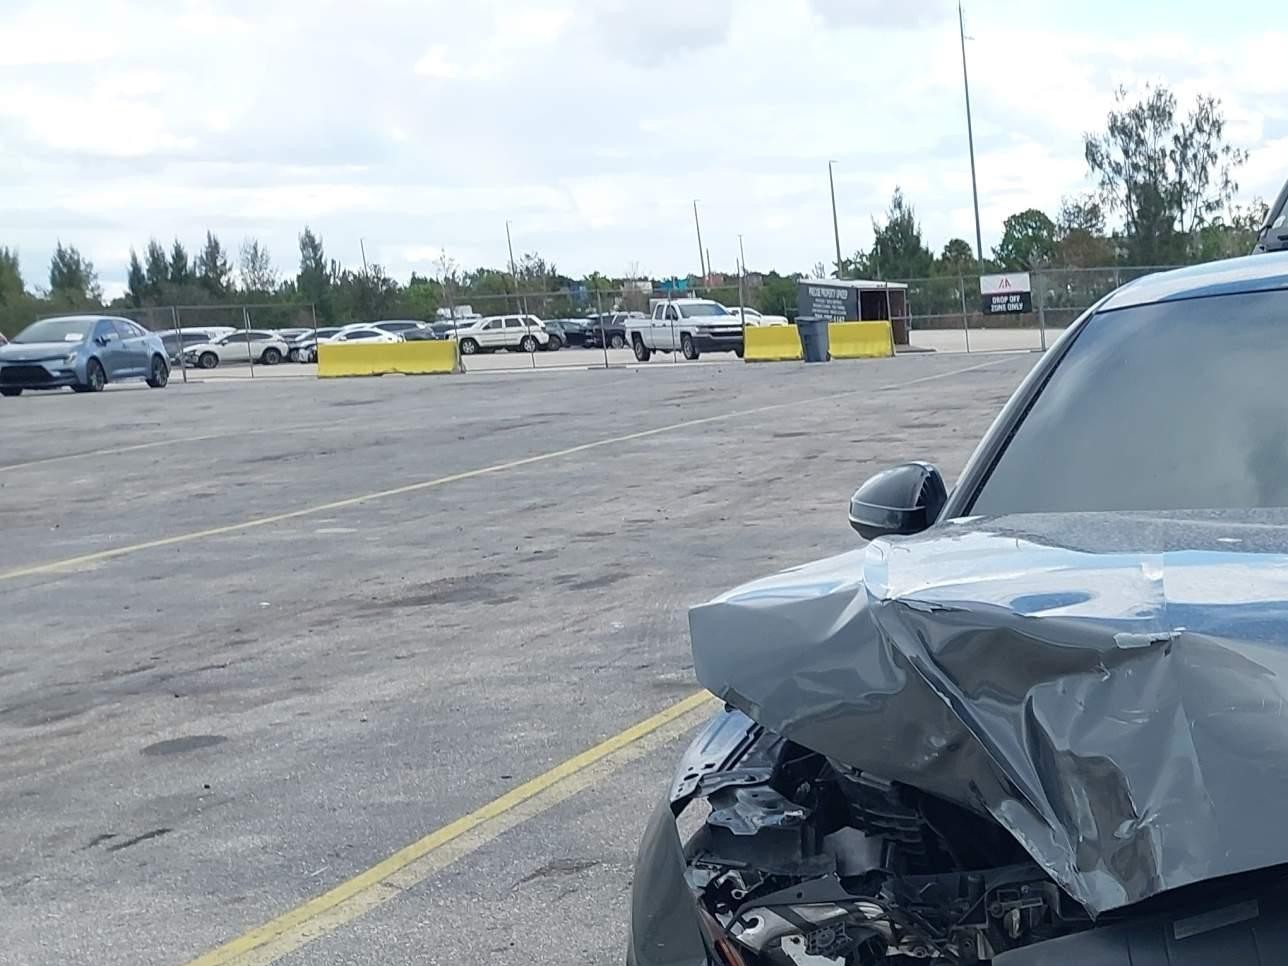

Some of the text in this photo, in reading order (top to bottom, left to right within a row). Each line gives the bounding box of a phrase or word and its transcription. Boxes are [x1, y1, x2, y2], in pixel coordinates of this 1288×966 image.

[992, 295, 1021, 304] DROP OFF
[991, 302, 1024, 312] ZONE ONLY
